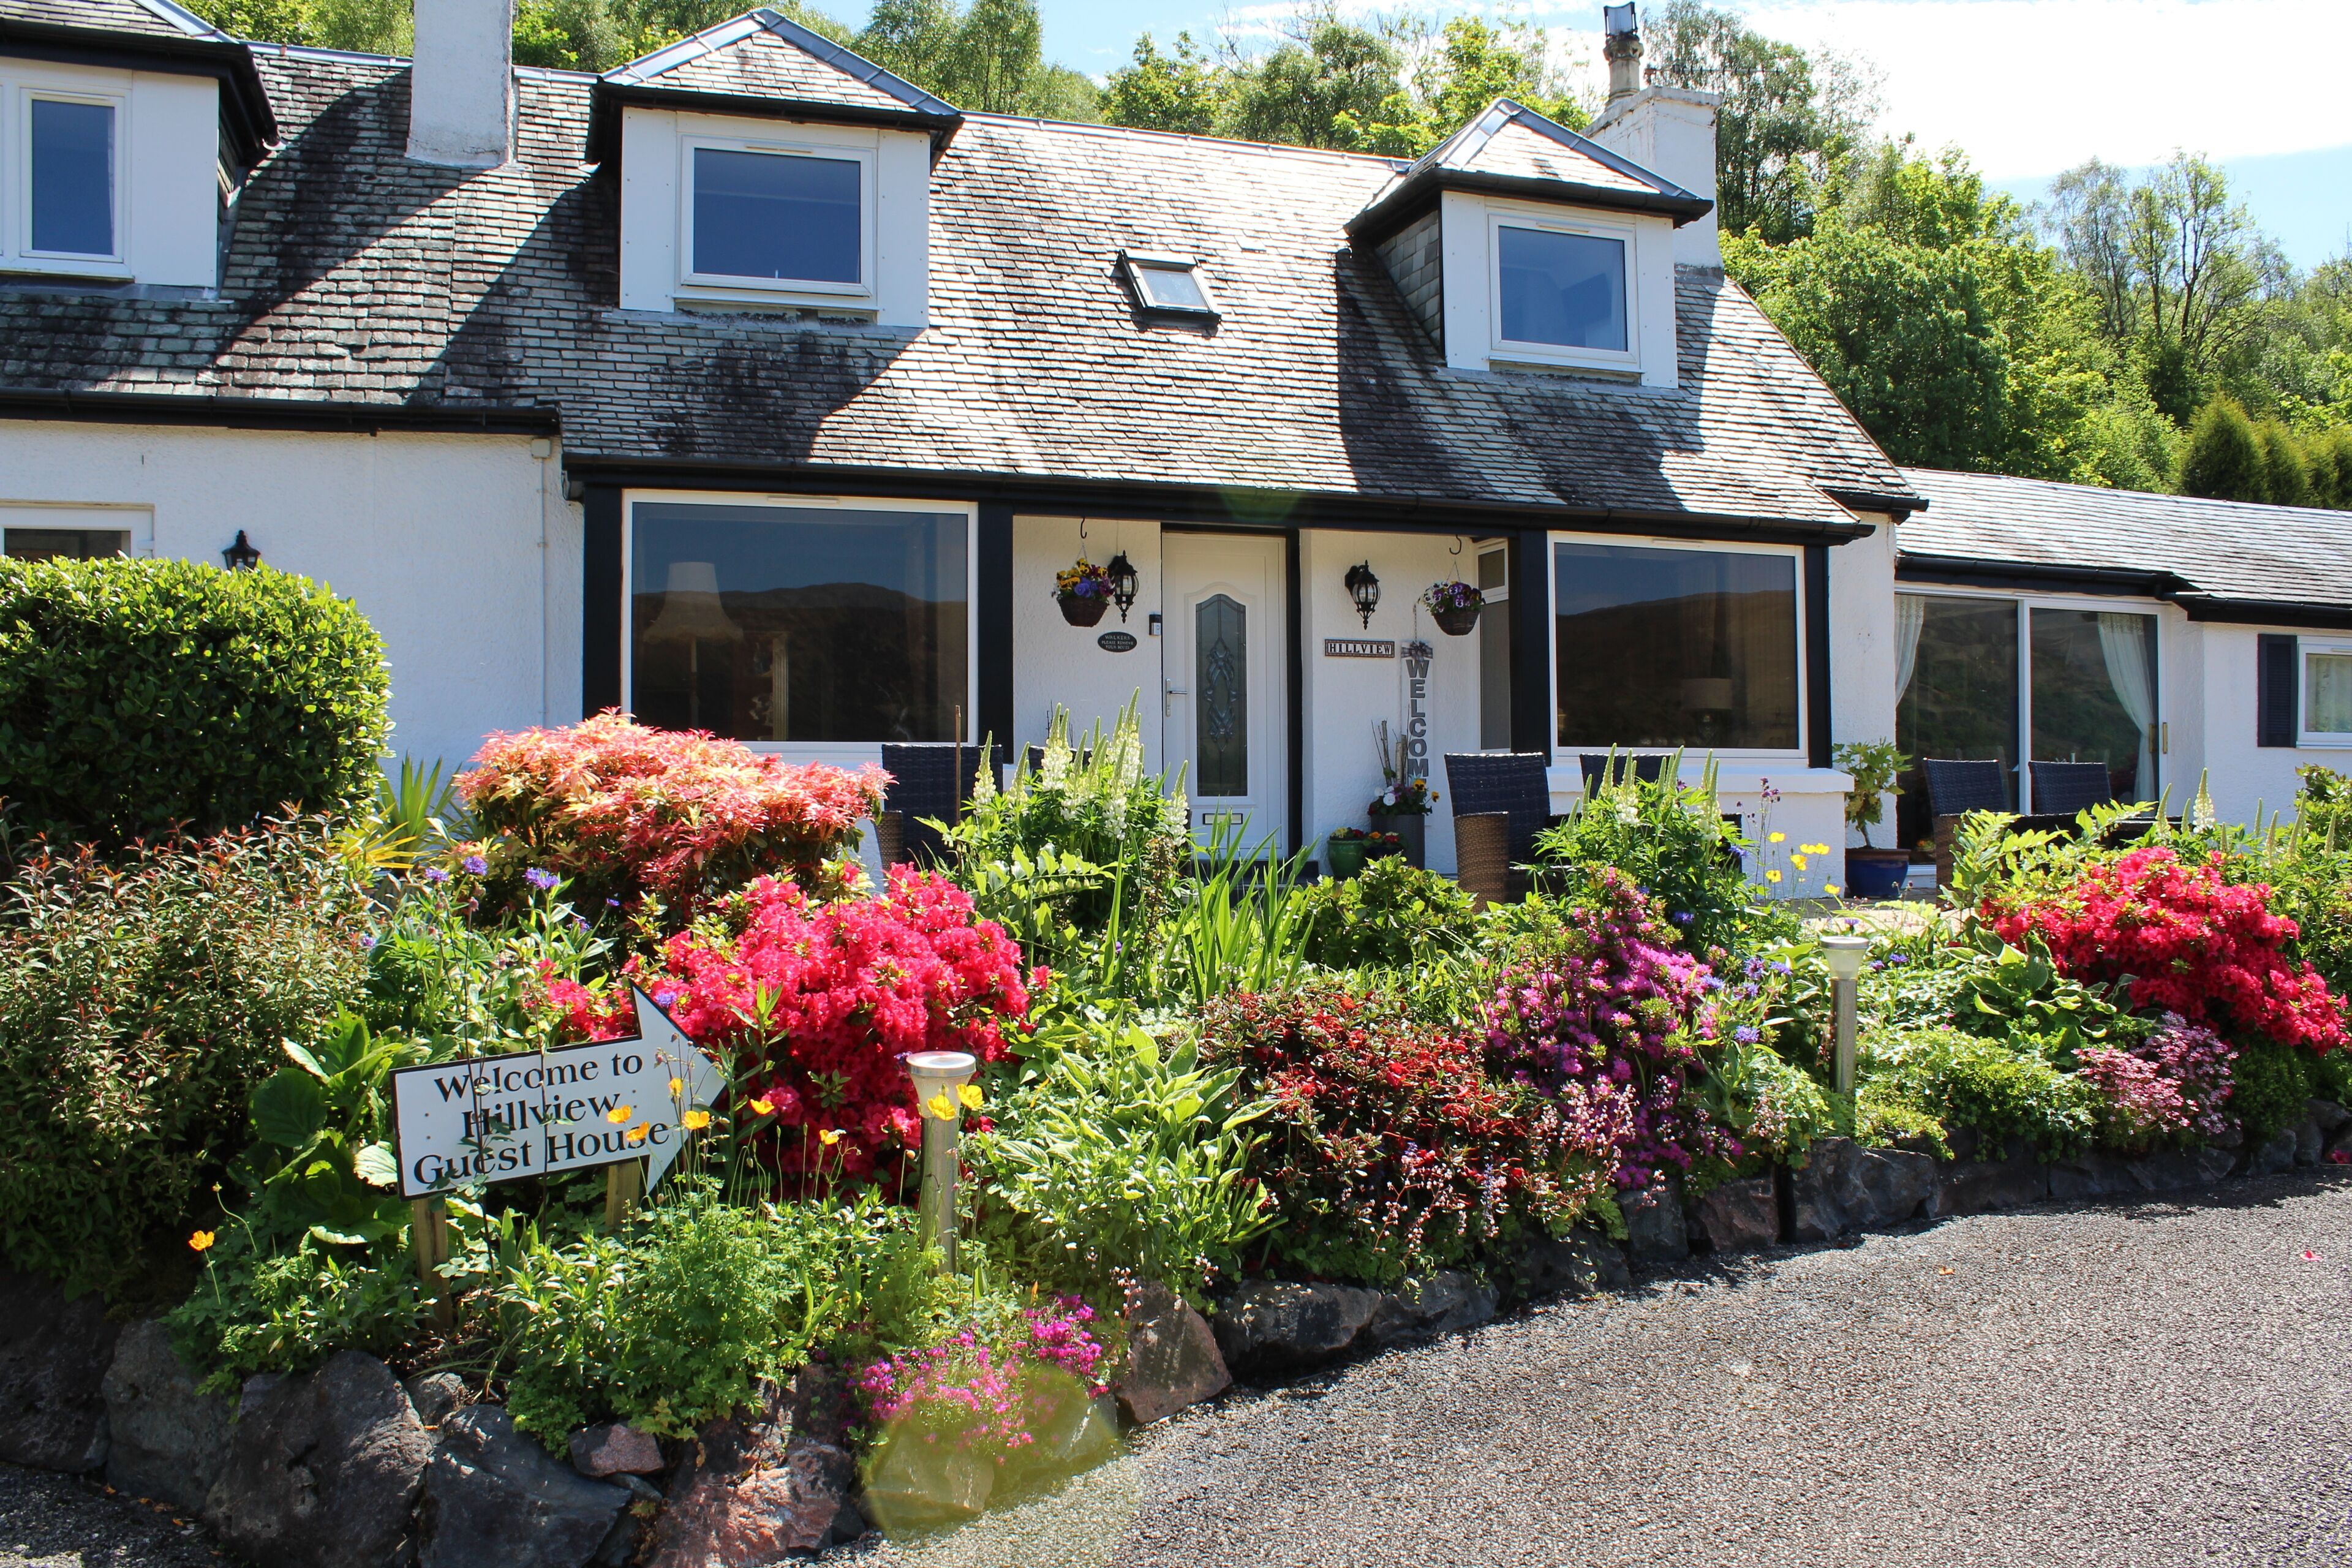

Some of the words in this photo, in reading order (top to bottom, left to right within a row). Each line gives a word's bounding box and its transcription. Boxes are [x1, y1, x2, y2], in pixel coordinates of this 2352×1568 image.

[1329, 643, 1390, 655] HILLVIEW
[1406, 659, 1430, 785] WELCOM
[434, 1060, 599, 1102] Welcome
[611, 1053, 643, 1076] to
[461, 1093, 620, 1138] Hillview
[413, 1140, 532, 1185] Guest
